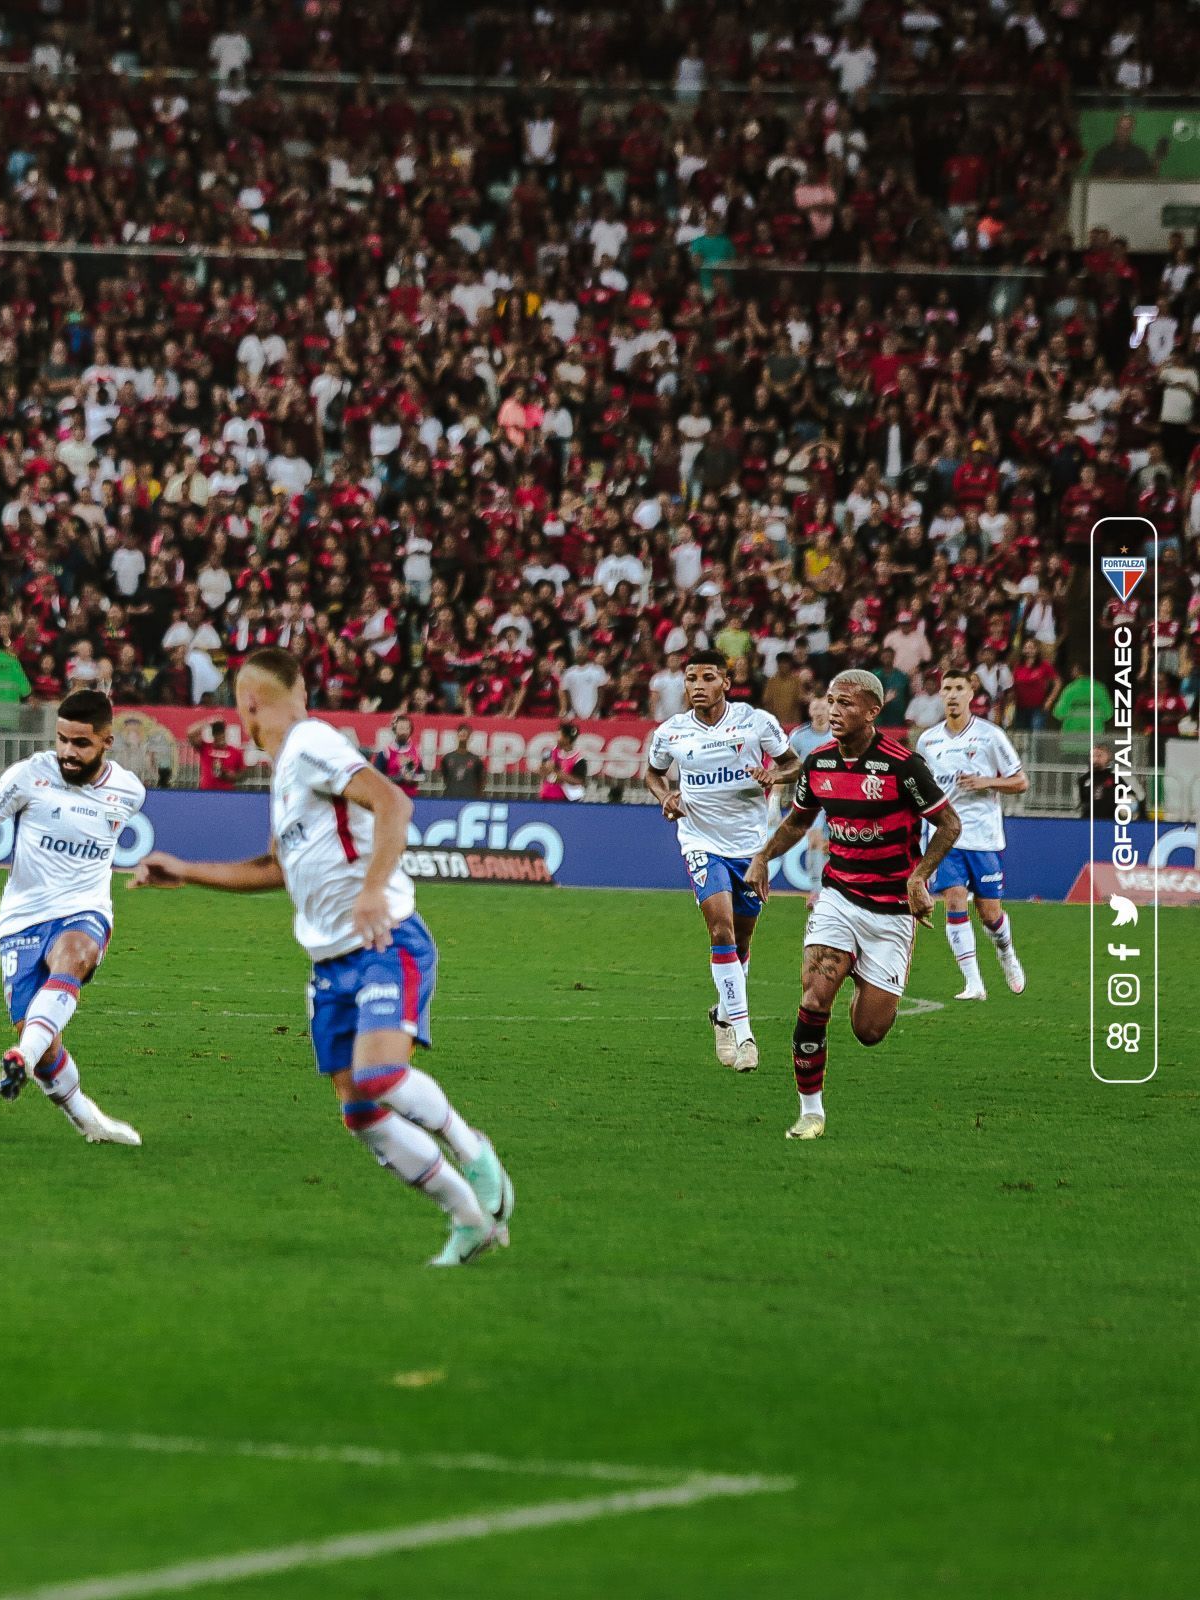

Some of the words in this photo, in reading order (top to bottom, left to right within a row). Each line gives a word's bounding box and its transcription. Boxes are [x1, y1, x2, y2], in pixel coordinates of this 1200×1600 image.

[40, 835, 110, 860] novibe
[401, 850, 471, 879] OSTA
[686, 851, 708, 872] 35
